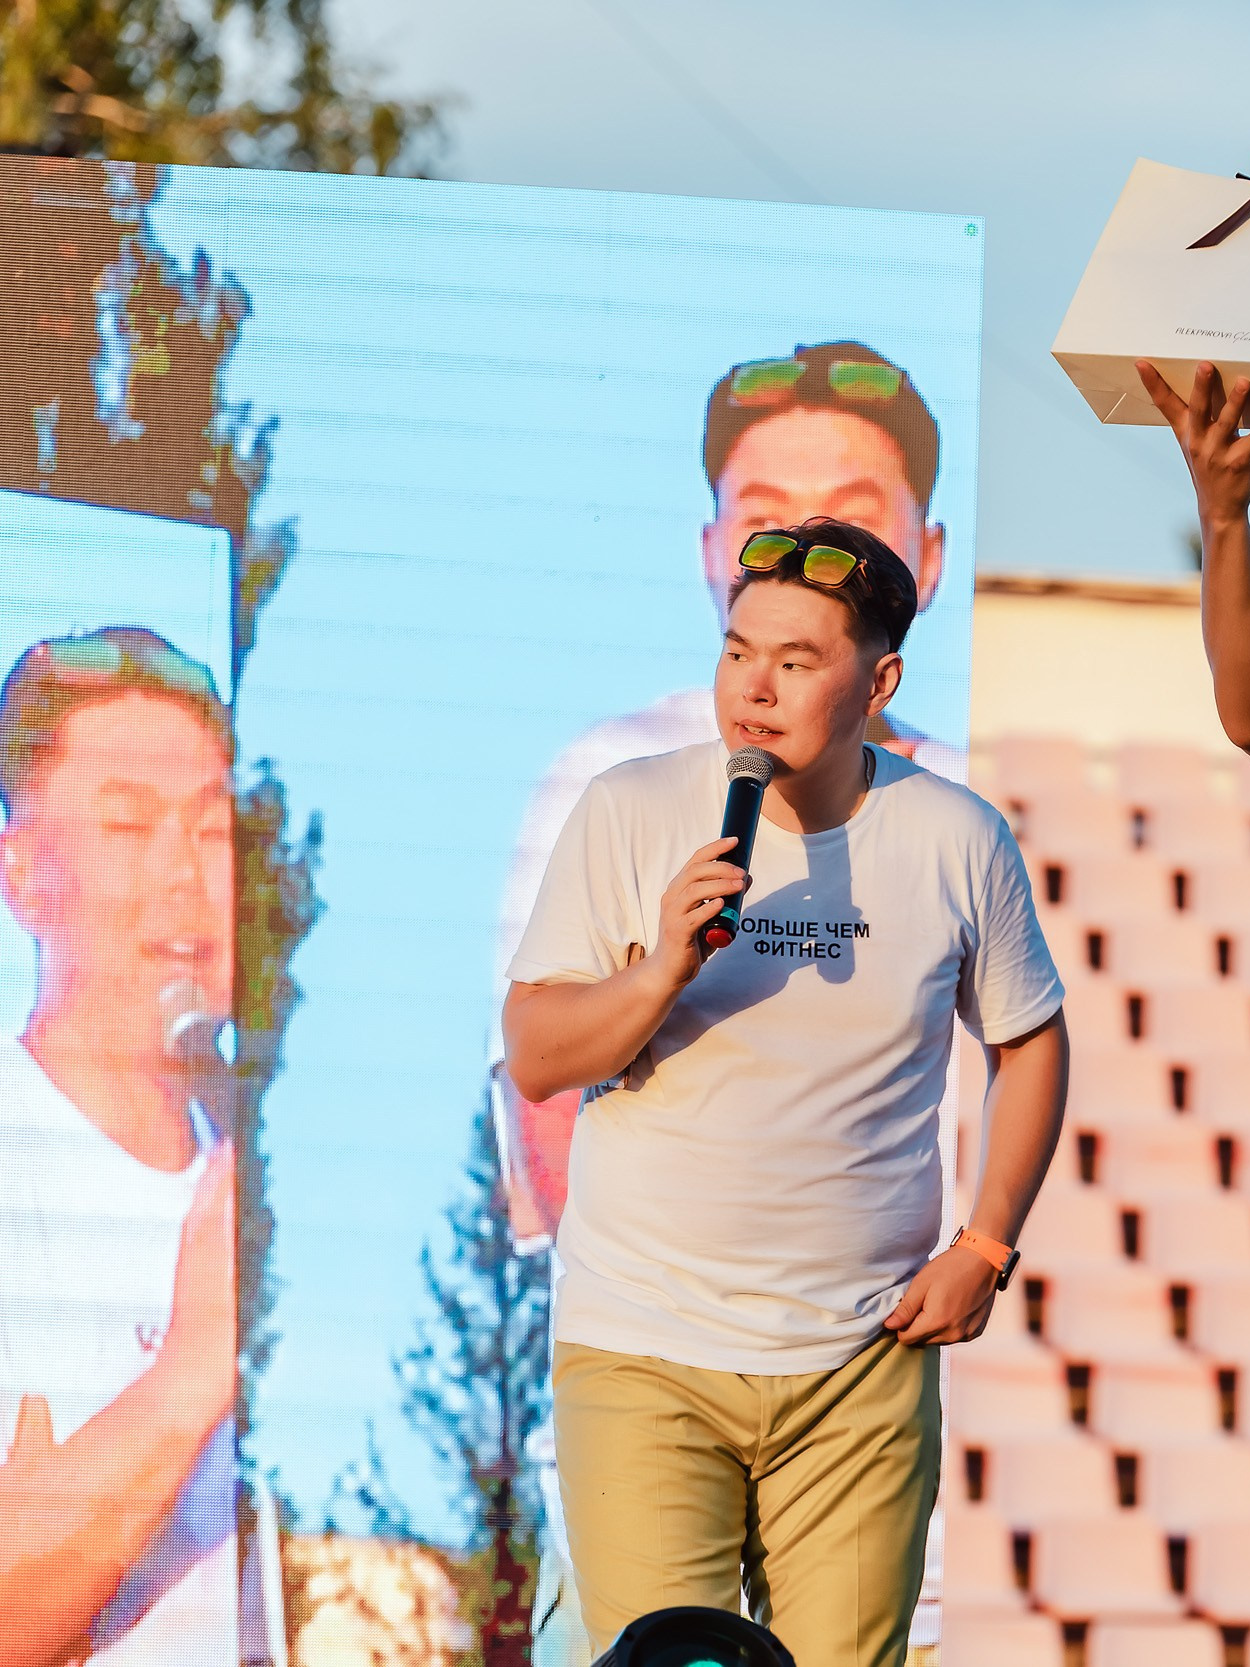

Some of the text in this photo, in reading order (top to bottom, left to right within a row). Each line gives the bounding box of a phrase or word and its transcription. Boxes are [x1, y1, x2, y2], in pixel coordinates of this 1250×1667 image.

[737, 917, 870, 939] ОЛЬШЕ ЧЕМ
[753, 939, 842, 959] ФИТНЕС
